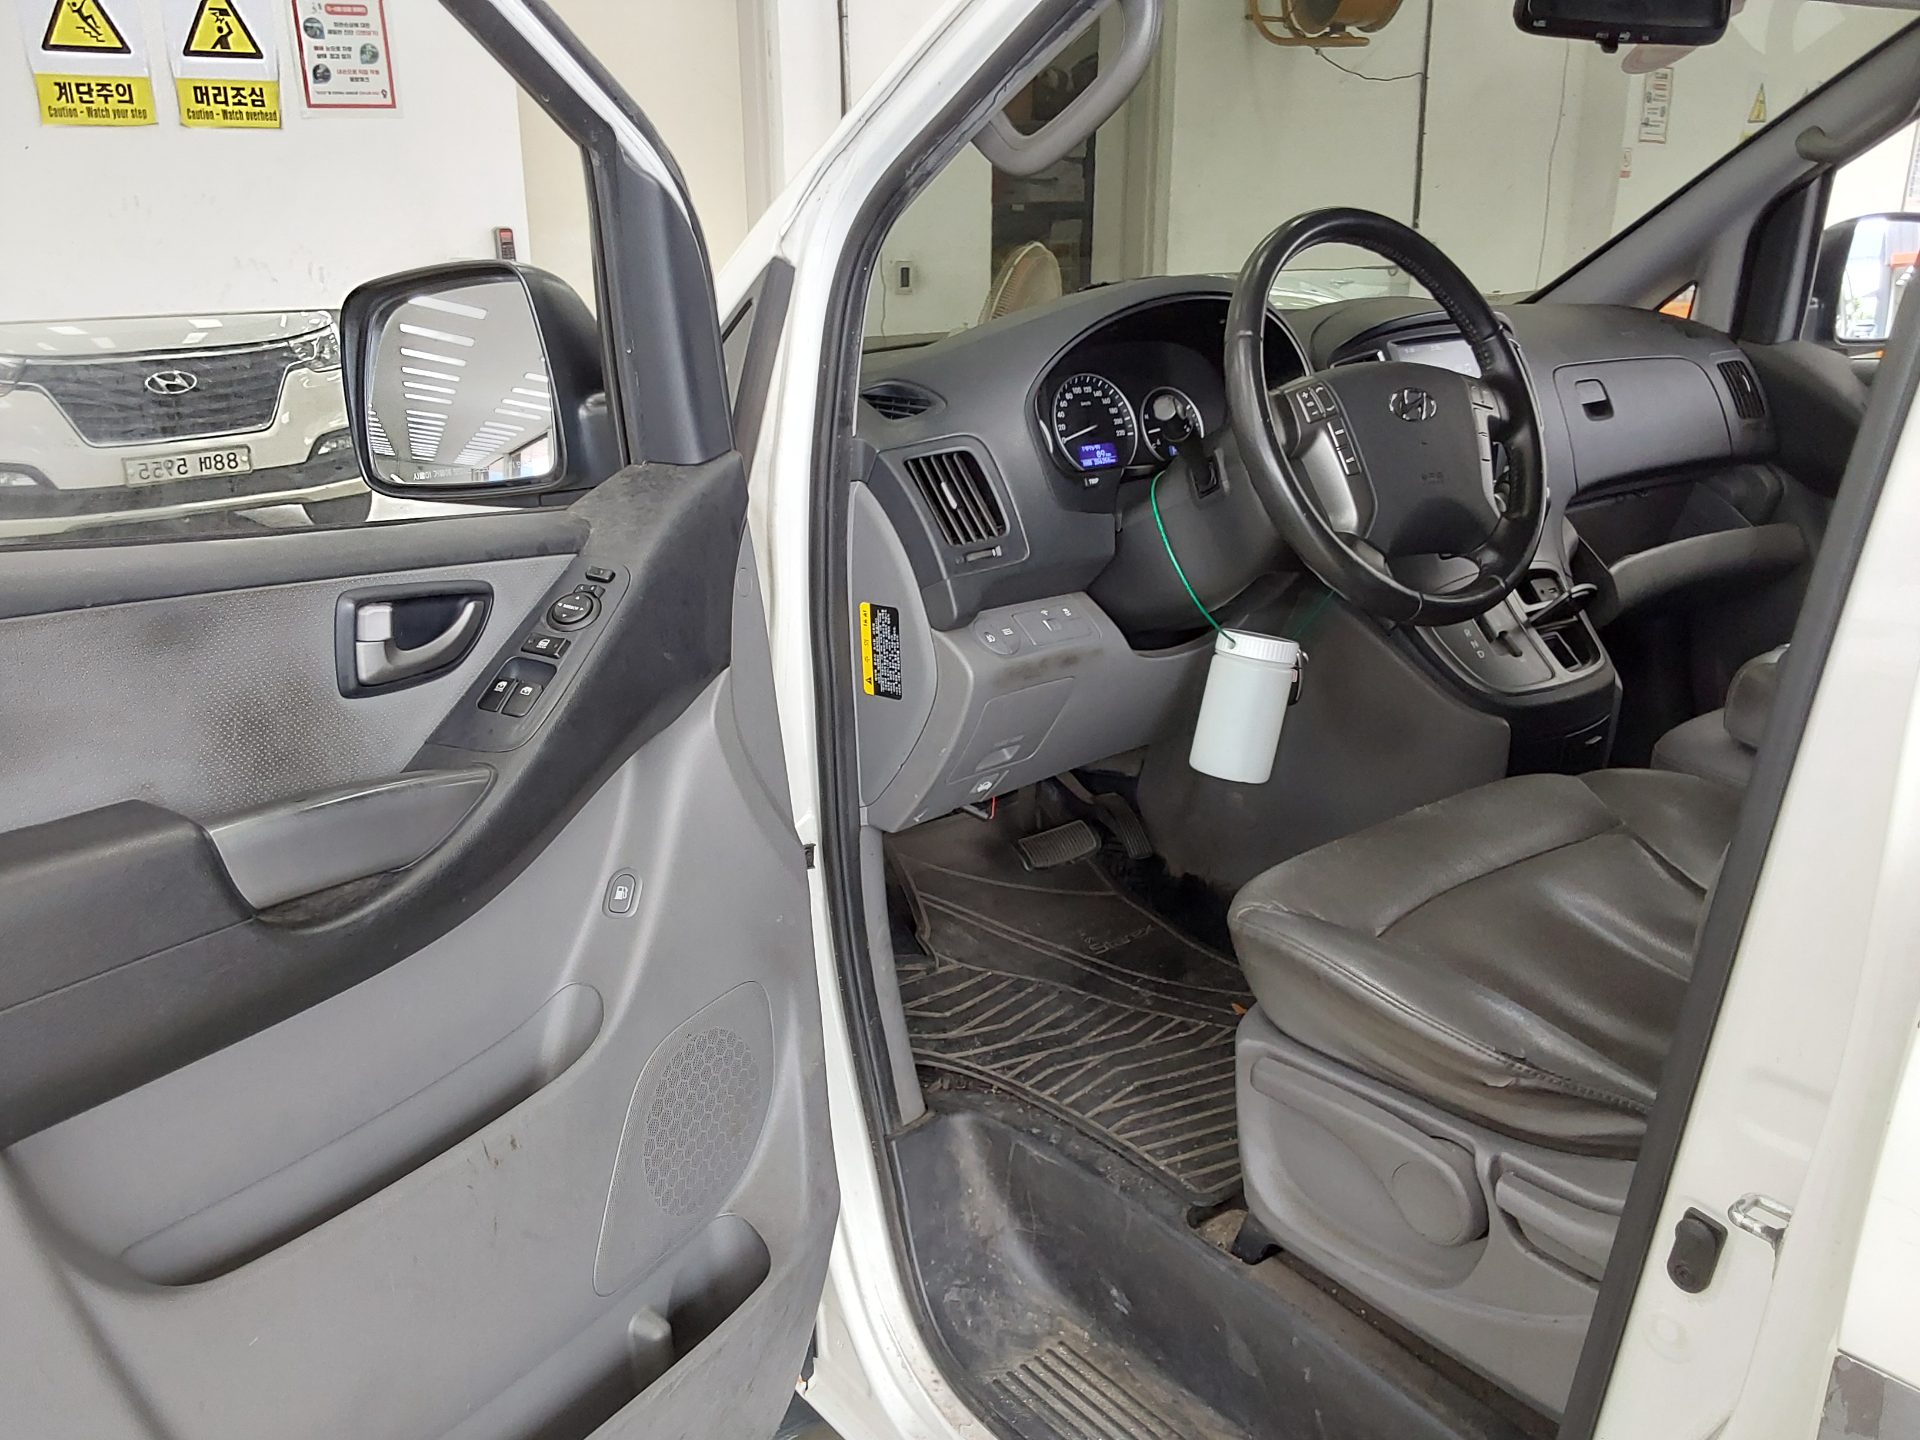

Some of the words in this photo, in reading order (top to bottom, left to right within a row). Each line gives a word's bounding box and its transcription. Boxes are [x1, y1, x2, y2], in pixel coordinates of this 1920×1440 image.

[53, 81, 135, 105] 계단주의
[192, 85, 266, 108] 머리조심
[48, 105, 79, 119] Caution
[86, 106, 111, 120] Watch
[112, 108, 129, 120] your
[131, 108, 148, 120] step
[186, 108, 214, 121] Caution
[221, 109, 245, 121] Watch
[245, 110, 278, 122] overhead
[1058, 423, 1066, 431] 20
[1470, 640, 1479, 649] N
[1476, 650, 1485, 659] D
